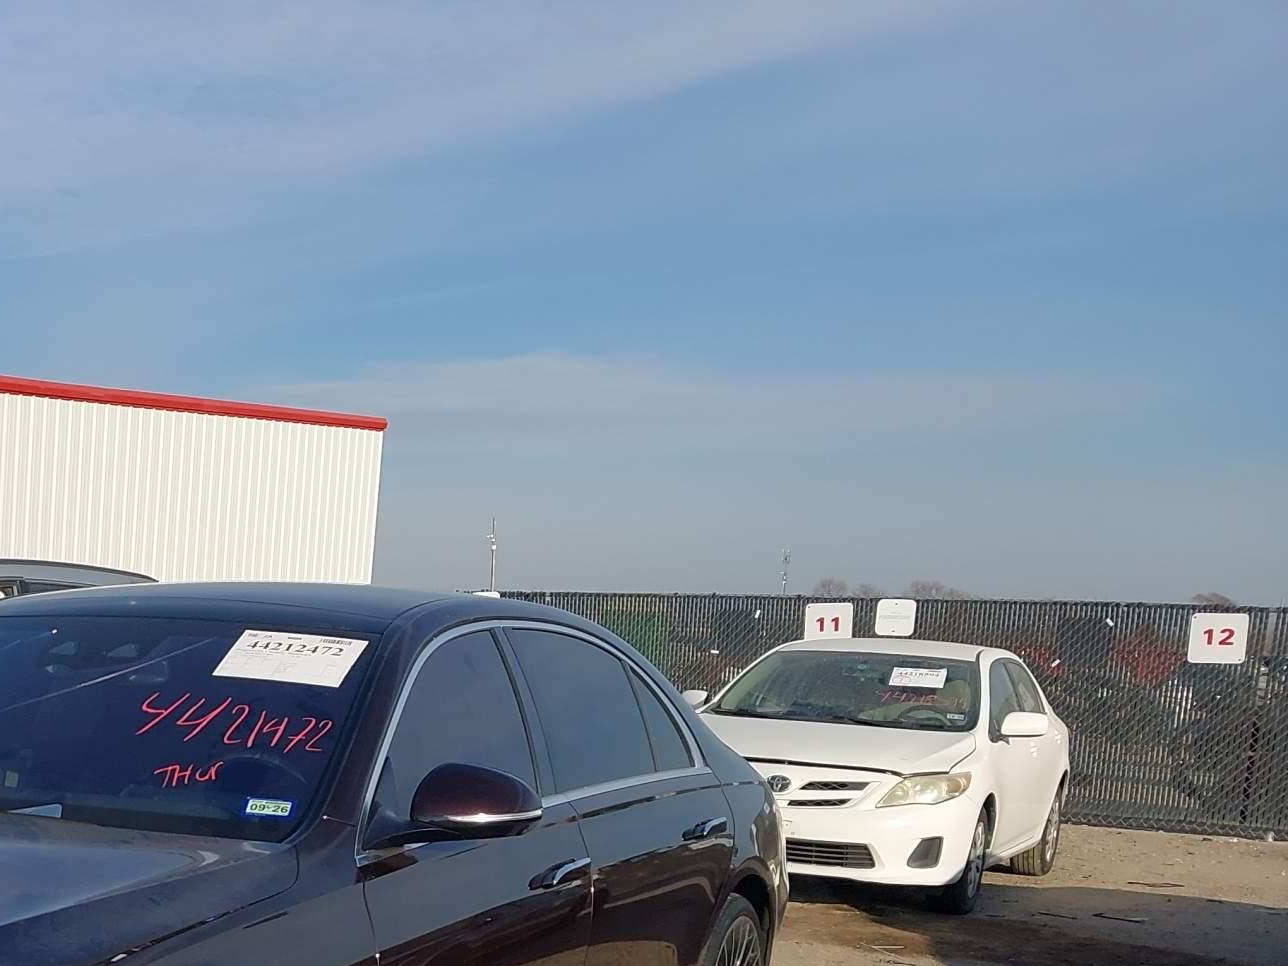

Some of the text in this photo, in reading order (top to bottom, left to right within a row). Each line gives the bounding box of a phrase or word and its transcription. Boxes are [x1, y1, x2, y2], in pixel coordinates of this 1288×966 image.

[816, 616, 840, 632] 11
[1203, 628, 1235, 645] 12
[246, 640, 345, 657] 44212472
[135, 691, 333, 754] 4421472
[272, 805, 289, 813] 26
